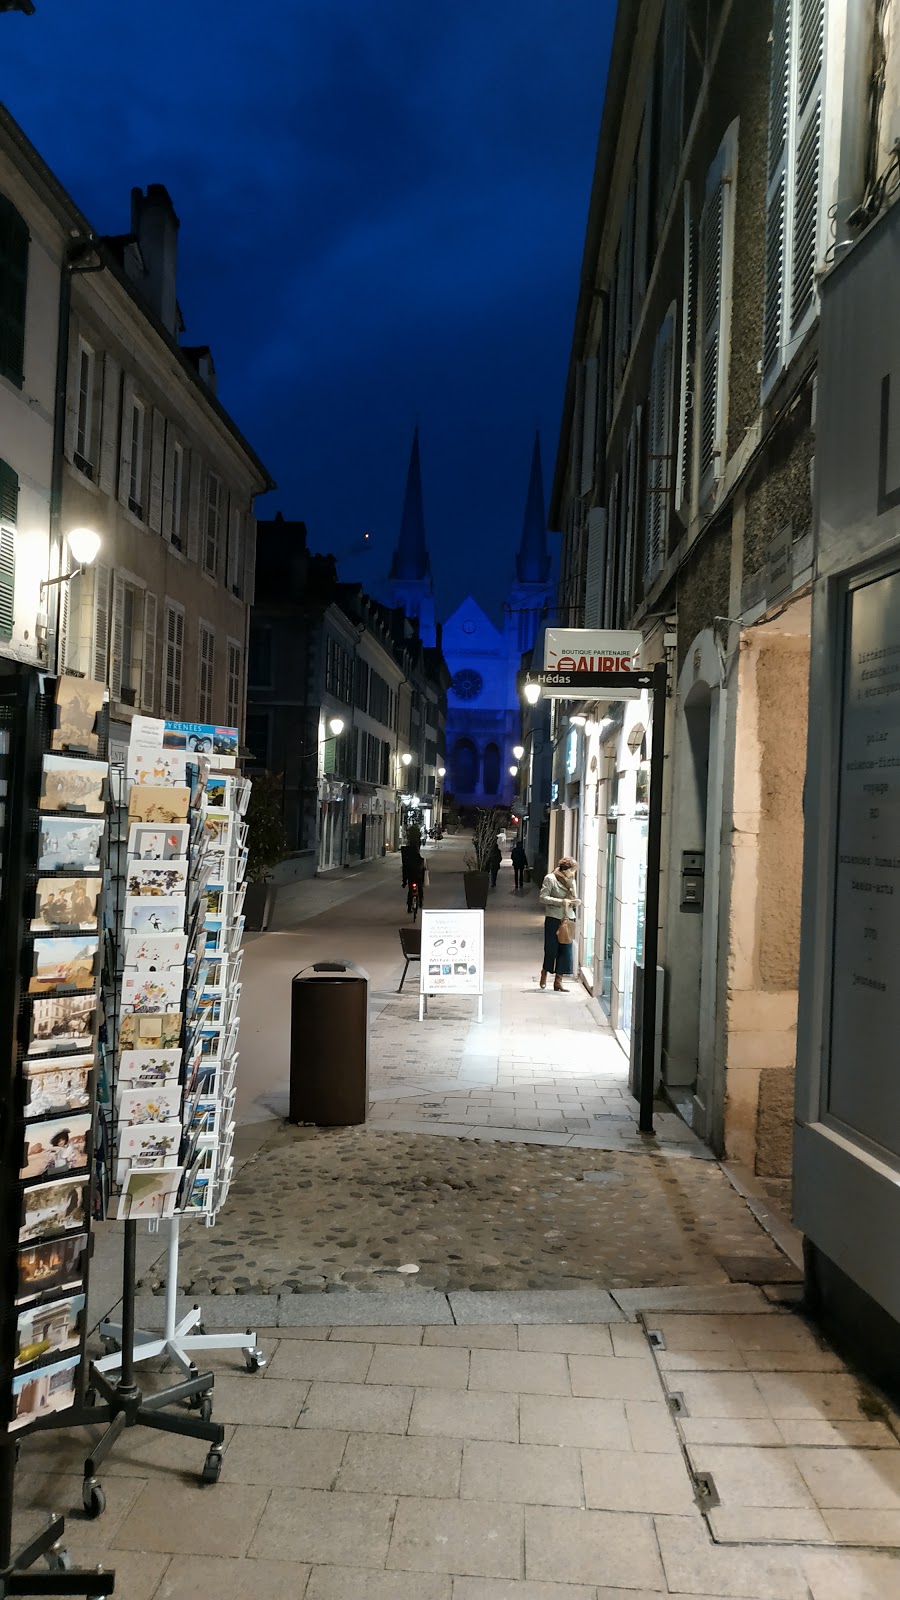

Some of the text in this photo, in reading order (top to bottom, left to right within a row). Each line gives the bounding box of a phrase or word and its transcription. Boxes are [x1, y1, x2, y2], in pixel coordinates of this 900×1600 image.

[577, 656, 632, 672] AURIS
[537, 673, 571, 684] Hédas
[852, 880, 894, 895] beaux-arts
